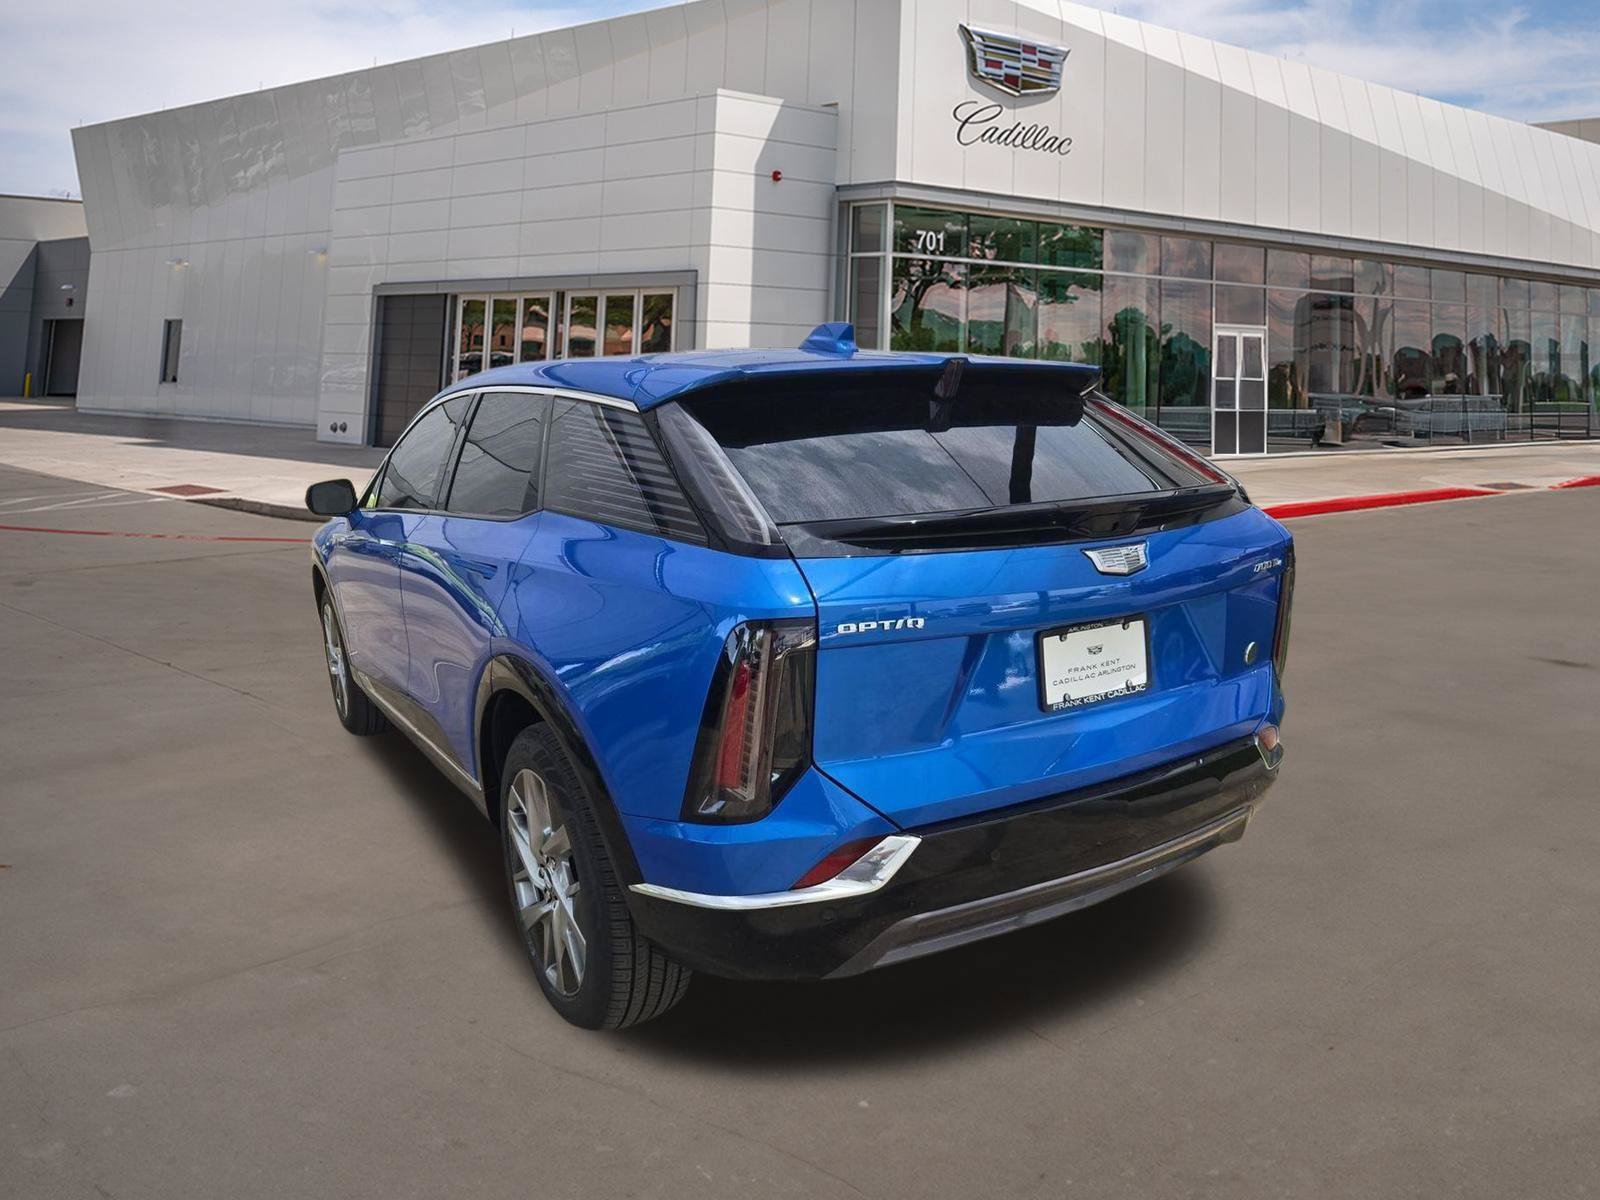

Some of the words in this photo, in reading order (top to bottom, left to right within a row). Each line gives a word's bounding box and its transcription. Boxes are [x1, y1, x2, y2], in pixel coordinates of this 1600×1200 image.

[952, 100, 1073, 156] Cadillac
[916, 229, 945, 252] 701
[837, 617, 925, 634] OPTIQ
[1052, 672, 1095, 686] CADILLAC
[1098, 663, 1136, 676] ARLINGTON
[1067, 664, 1097, 674] FRANK
[1100, 658, 1121, 668] KENT
[1053, 699, 1081, 710] FRANK
[1083, 694, 1106, 704] KENT
[1107, 684, 1146, 698] CADILLAC
